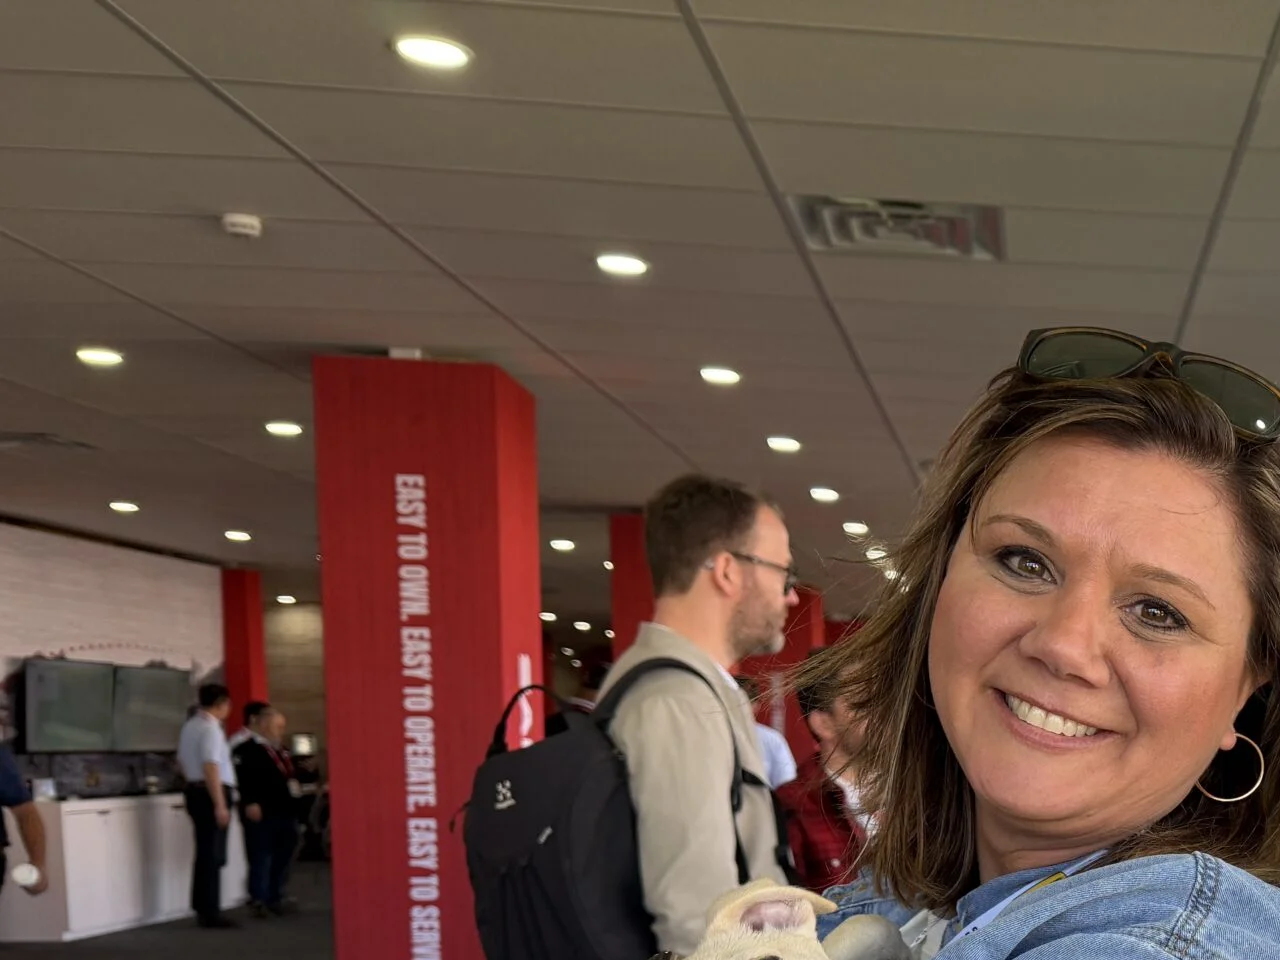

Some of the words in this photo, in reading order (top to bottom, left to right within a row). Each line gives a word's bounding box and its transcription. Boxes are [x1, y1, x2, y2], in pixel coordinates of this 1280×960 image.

[395, 473, 425, 529] EASY
[397, 532, 427, 560] TO
[398, 564, 430, 621] OWN.
[400, 626, 432, 681] EASY
[402, 683, 434, 711] TO
[404, 715, 437, 812] OPERATE.
[407, 817, 439, 871] EASY
[408, 874, 440, 901] TO
